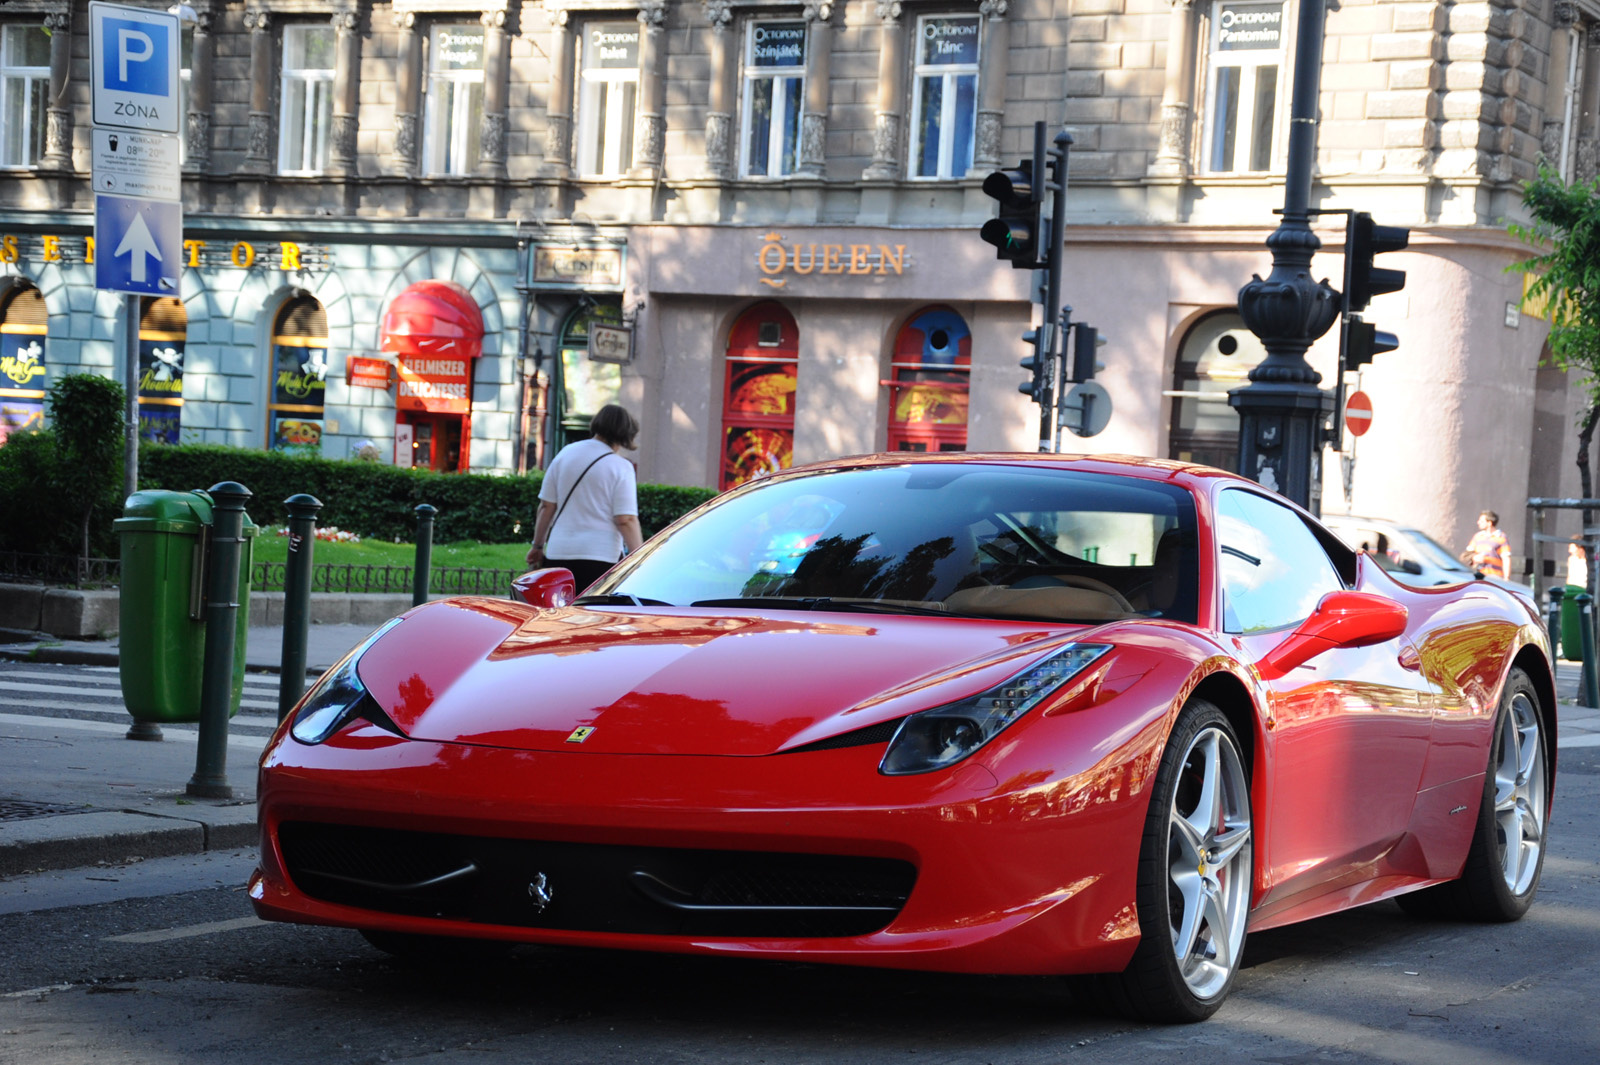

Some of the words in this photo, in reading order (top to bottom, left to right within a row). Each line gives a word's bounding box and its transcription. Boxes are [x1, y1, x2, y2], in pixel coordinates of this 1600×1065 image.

[1221, 10, 1281, 28] OCTOPONT
[753, 27, 804, 43] OCTOPONT
[924, 24, 978, 40] OCTOPONT
[1219, 27, 1279, 43] Pantomim
[118, 28, 154, 82] P
[753, 43, 802, 60] Színjáték
[936, 40, 964, 54] Tánc
[114, 100, 159, 120] ZÓNA
[758, 243, 907, 288] QUEEN
[403, 357, 466, 377] ÉLELMISZER
[400, 381, 468, 398] DELICATESSE
